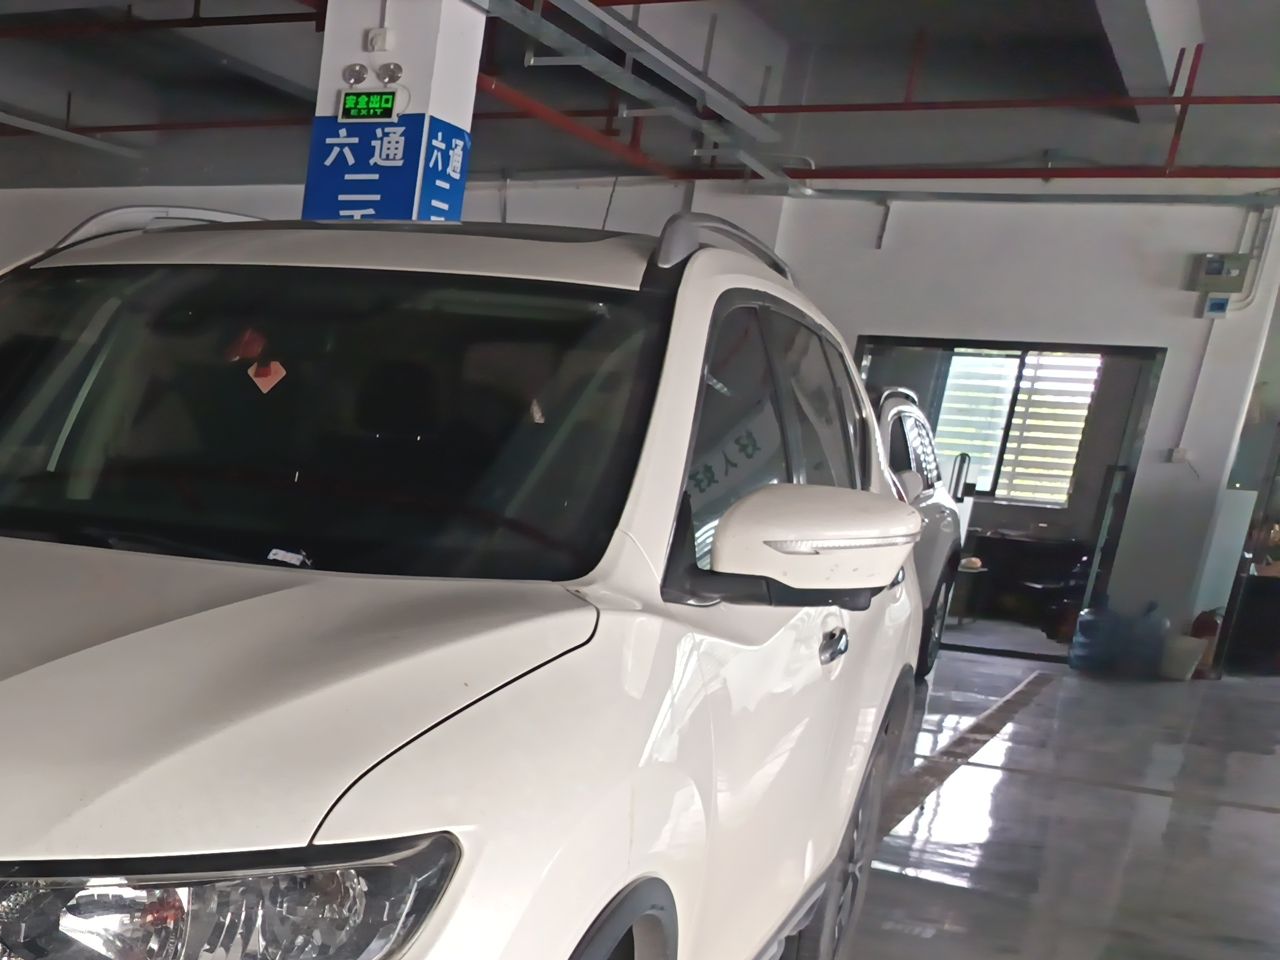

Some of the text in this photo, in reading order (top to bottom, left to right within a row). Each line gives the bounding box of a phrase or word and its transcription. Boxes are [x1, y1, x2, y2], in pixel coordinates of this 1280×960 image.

[345, 94, 393, 108] 安全出口
[350, 108, 384, 116] EXIT
[324, 126, 406, 166] 六通
[429, 131, 464, 180] 六通
